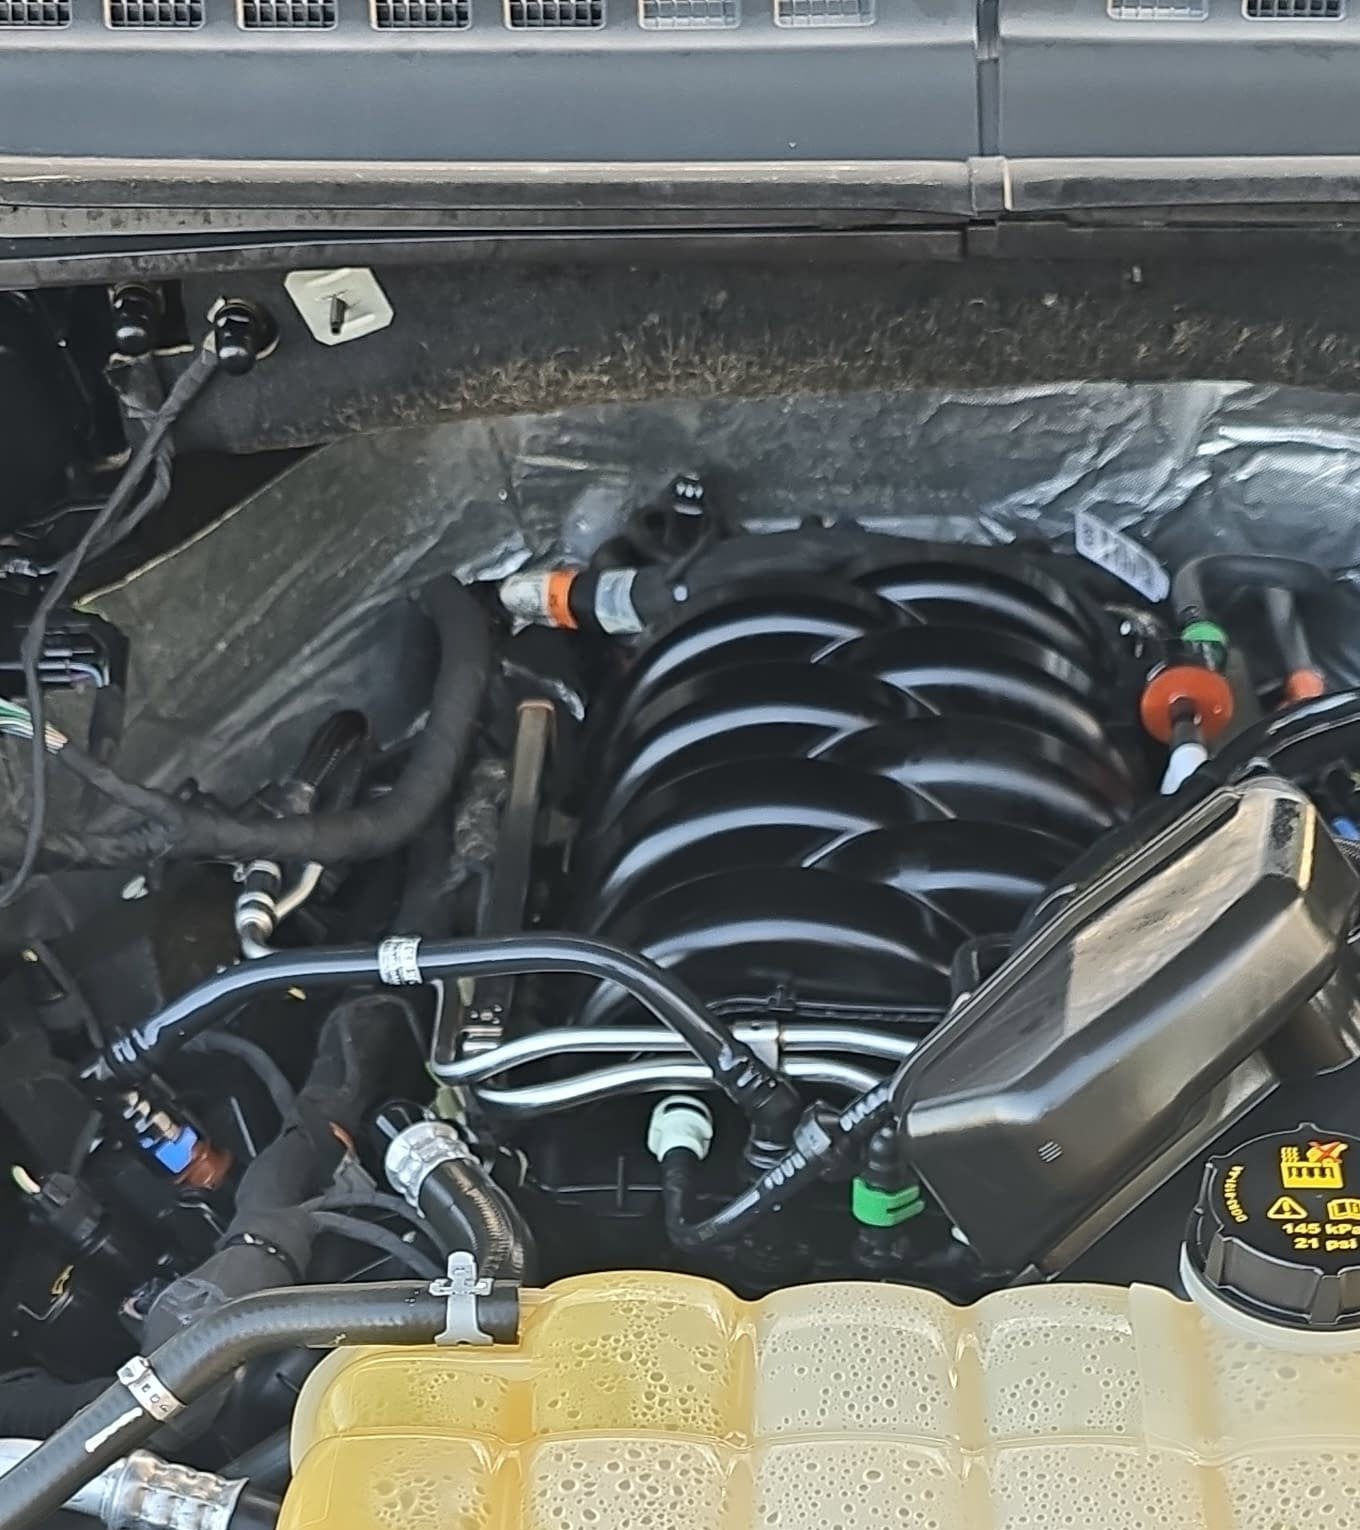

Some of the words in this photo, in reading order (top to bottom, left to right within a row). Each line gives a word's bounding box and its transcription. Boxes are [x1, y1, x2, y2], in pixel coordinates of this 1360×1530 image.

[1282, 1223, 1321, 1234] 145
[1294, 1237, 1319, 1249] 21
[1326, 1238, 1358, 1252] psi
